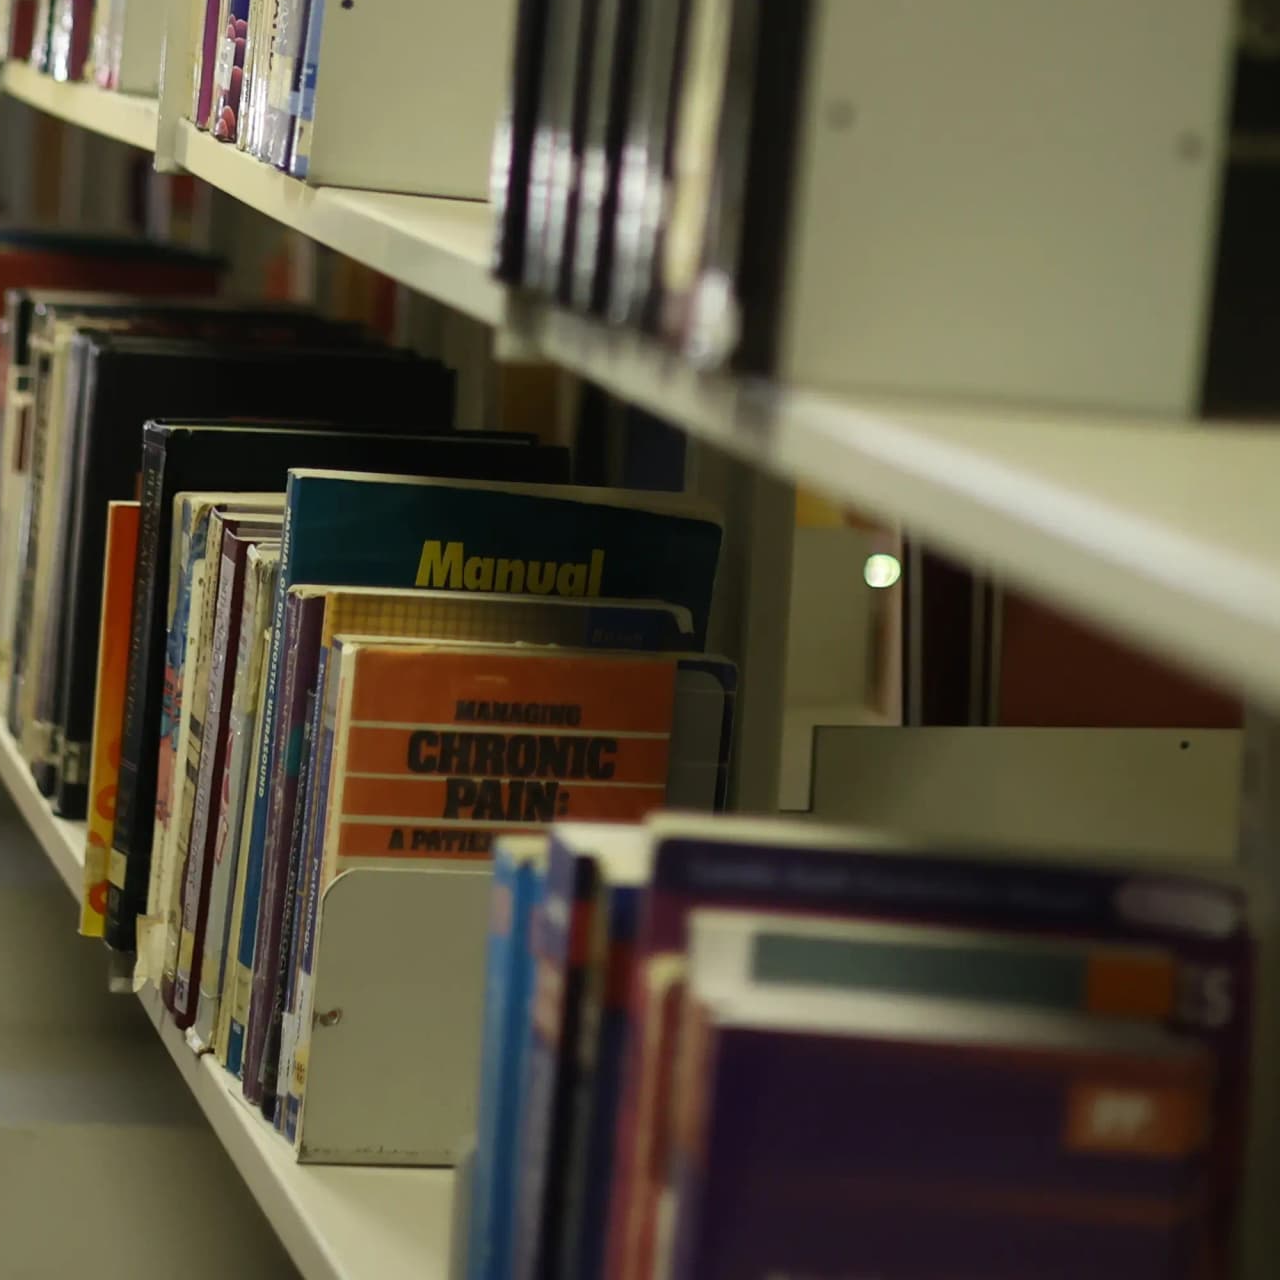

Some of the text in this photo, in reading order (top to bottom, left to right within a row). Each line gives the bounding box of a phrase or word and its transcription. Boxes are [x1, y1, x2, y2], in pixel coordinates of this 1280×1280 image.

[281, 506, 293, 571] MANUAL
[278, 575, 287, 597] OF
[415, 539, 605, 598] Manual
[269, 601, 284, 696] DIAGNOSTIC
[454, 700, 582, 726] MANAGING
[258, 698, 274, 798] ULTRASOUND
[407, 729, 618, 780] CHRONIC
[443, 778, 570, 822] PAIN:
[388, 828, 405, 851] A
[304, 857, 319, 954] Pathology
